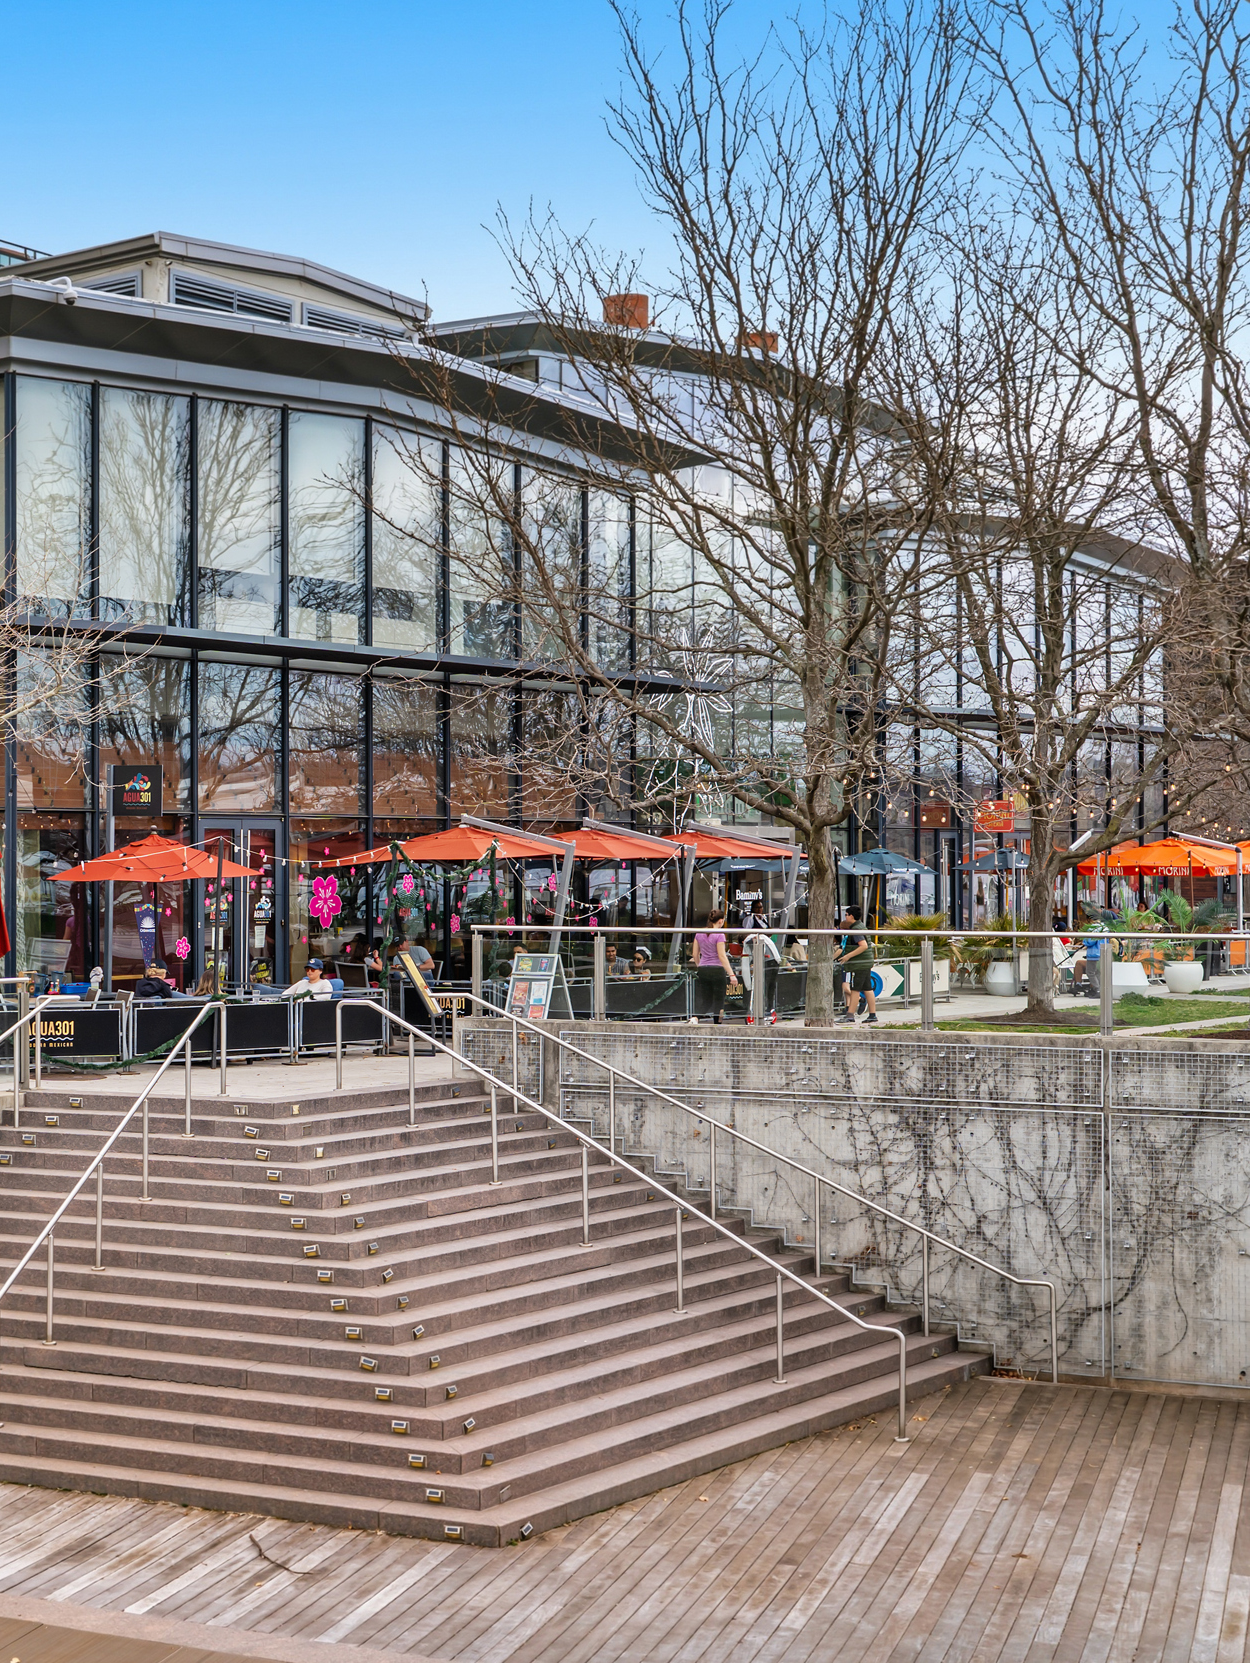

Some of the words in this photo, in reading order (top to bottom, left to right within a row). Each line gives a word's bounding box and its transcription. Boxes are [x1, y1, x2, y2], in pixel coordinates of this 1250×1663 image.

[123, 792, 151, 802] AGUA301
[1158, 866, 1190, 876] MORINI
[735, 888, 763, 900] Bammy's
